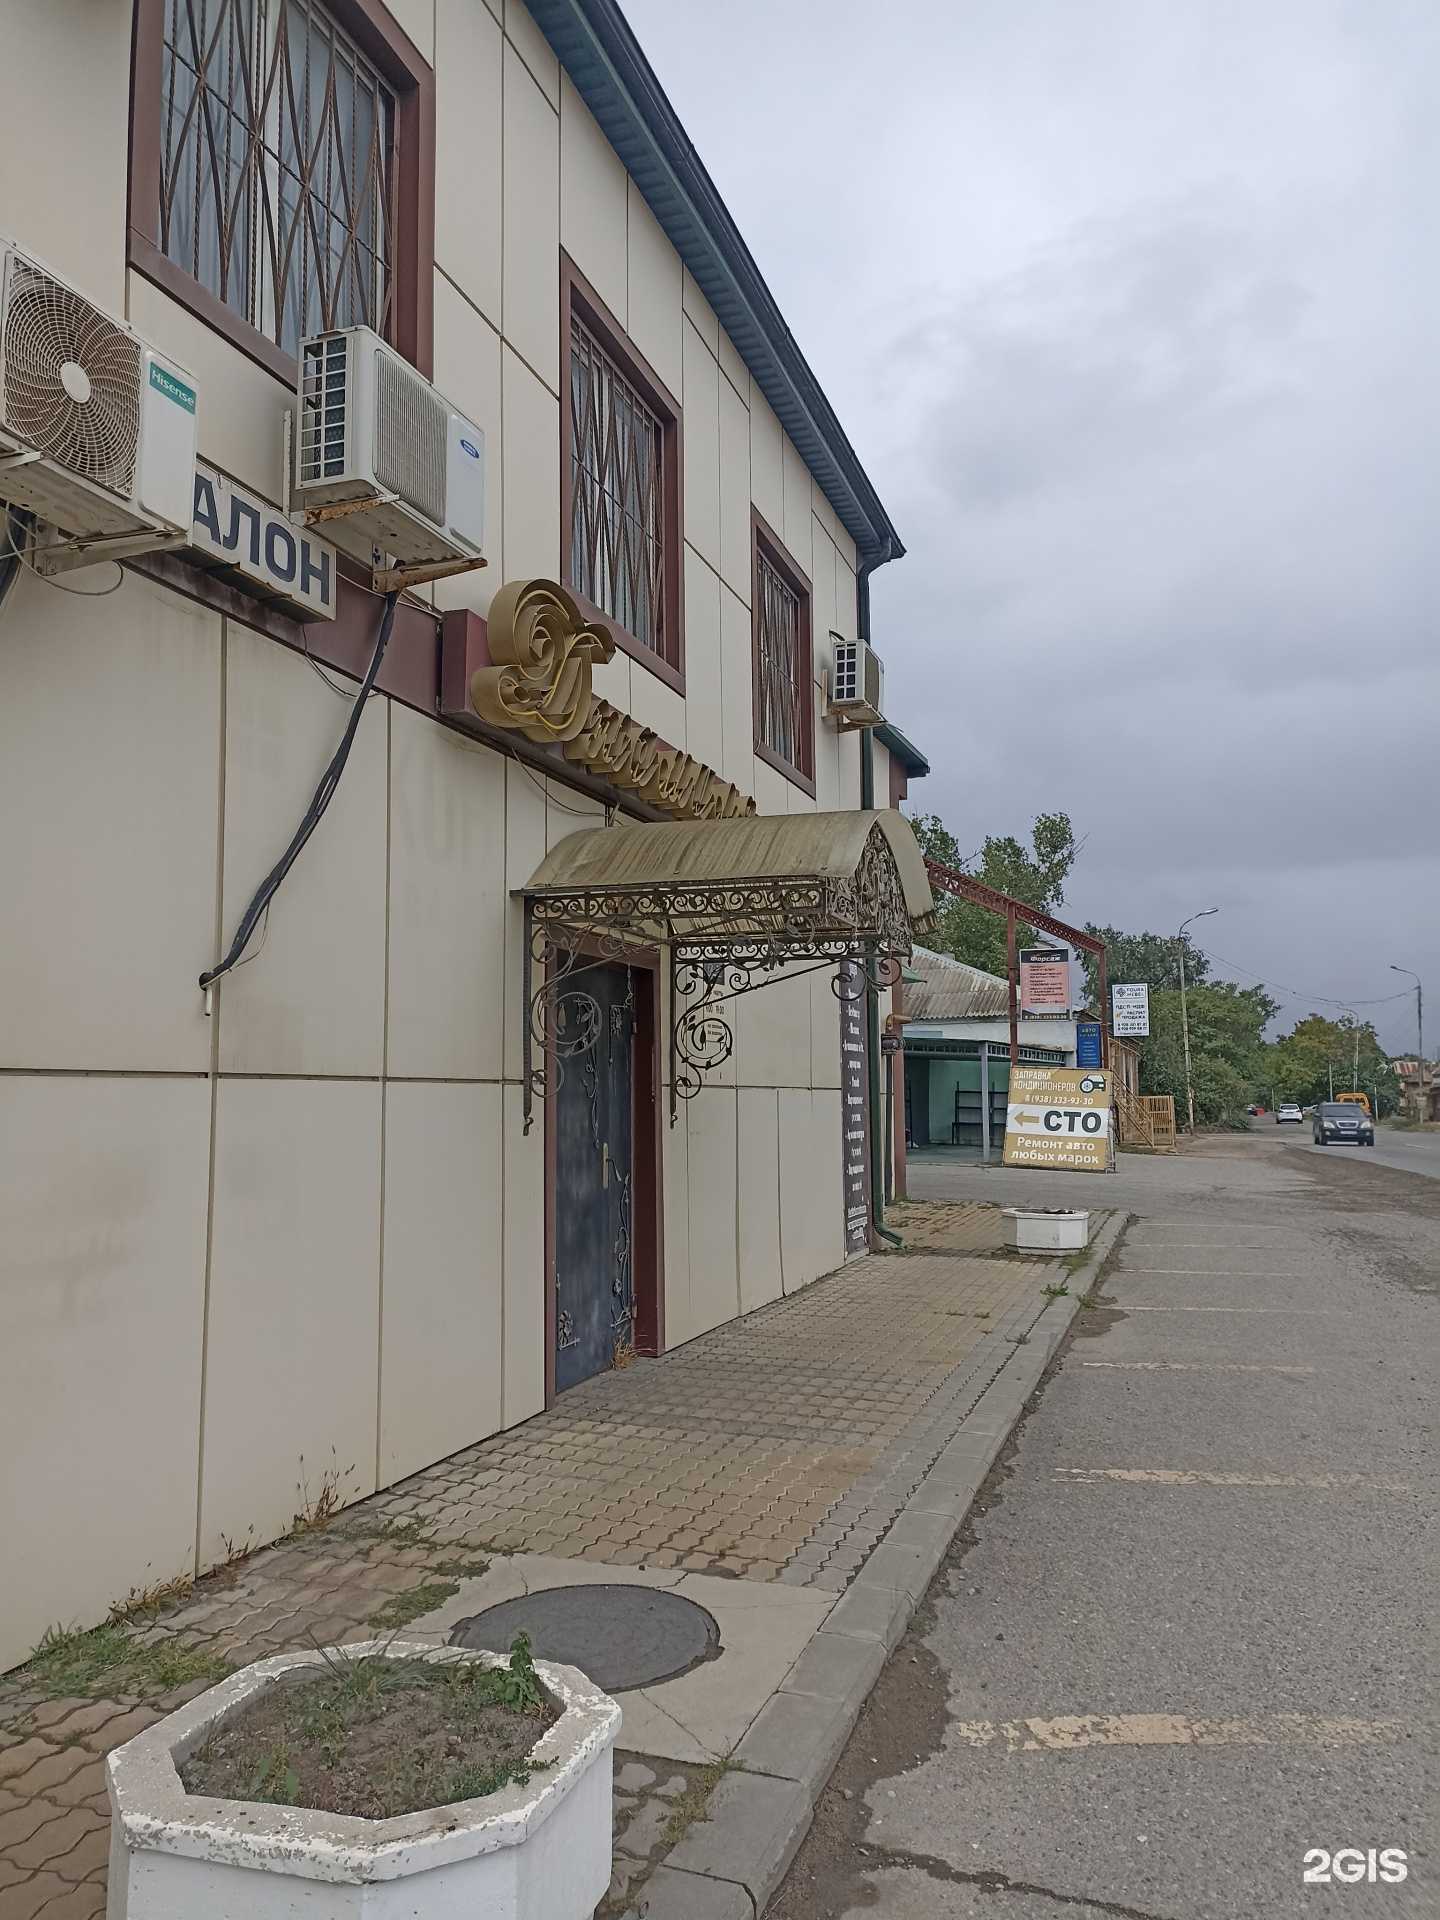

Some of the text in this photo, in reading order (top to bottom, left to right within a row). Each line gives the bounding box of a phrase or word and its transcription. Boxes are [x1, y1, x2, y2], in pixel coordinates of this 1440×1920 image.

[152, 369, 194, 407] Hisense
[1014, 1070, 1051, 1080] ЗАПРАВКА
[1013, 1080, 1076, 1092] КОНДИЦИОНЕРОВ
[1043, 1110, 1102, 1133] СТО
[1017, 1136, 1095, 1151] Ремонт авто
[1010, 1150, 1099, 1165] любых марок
